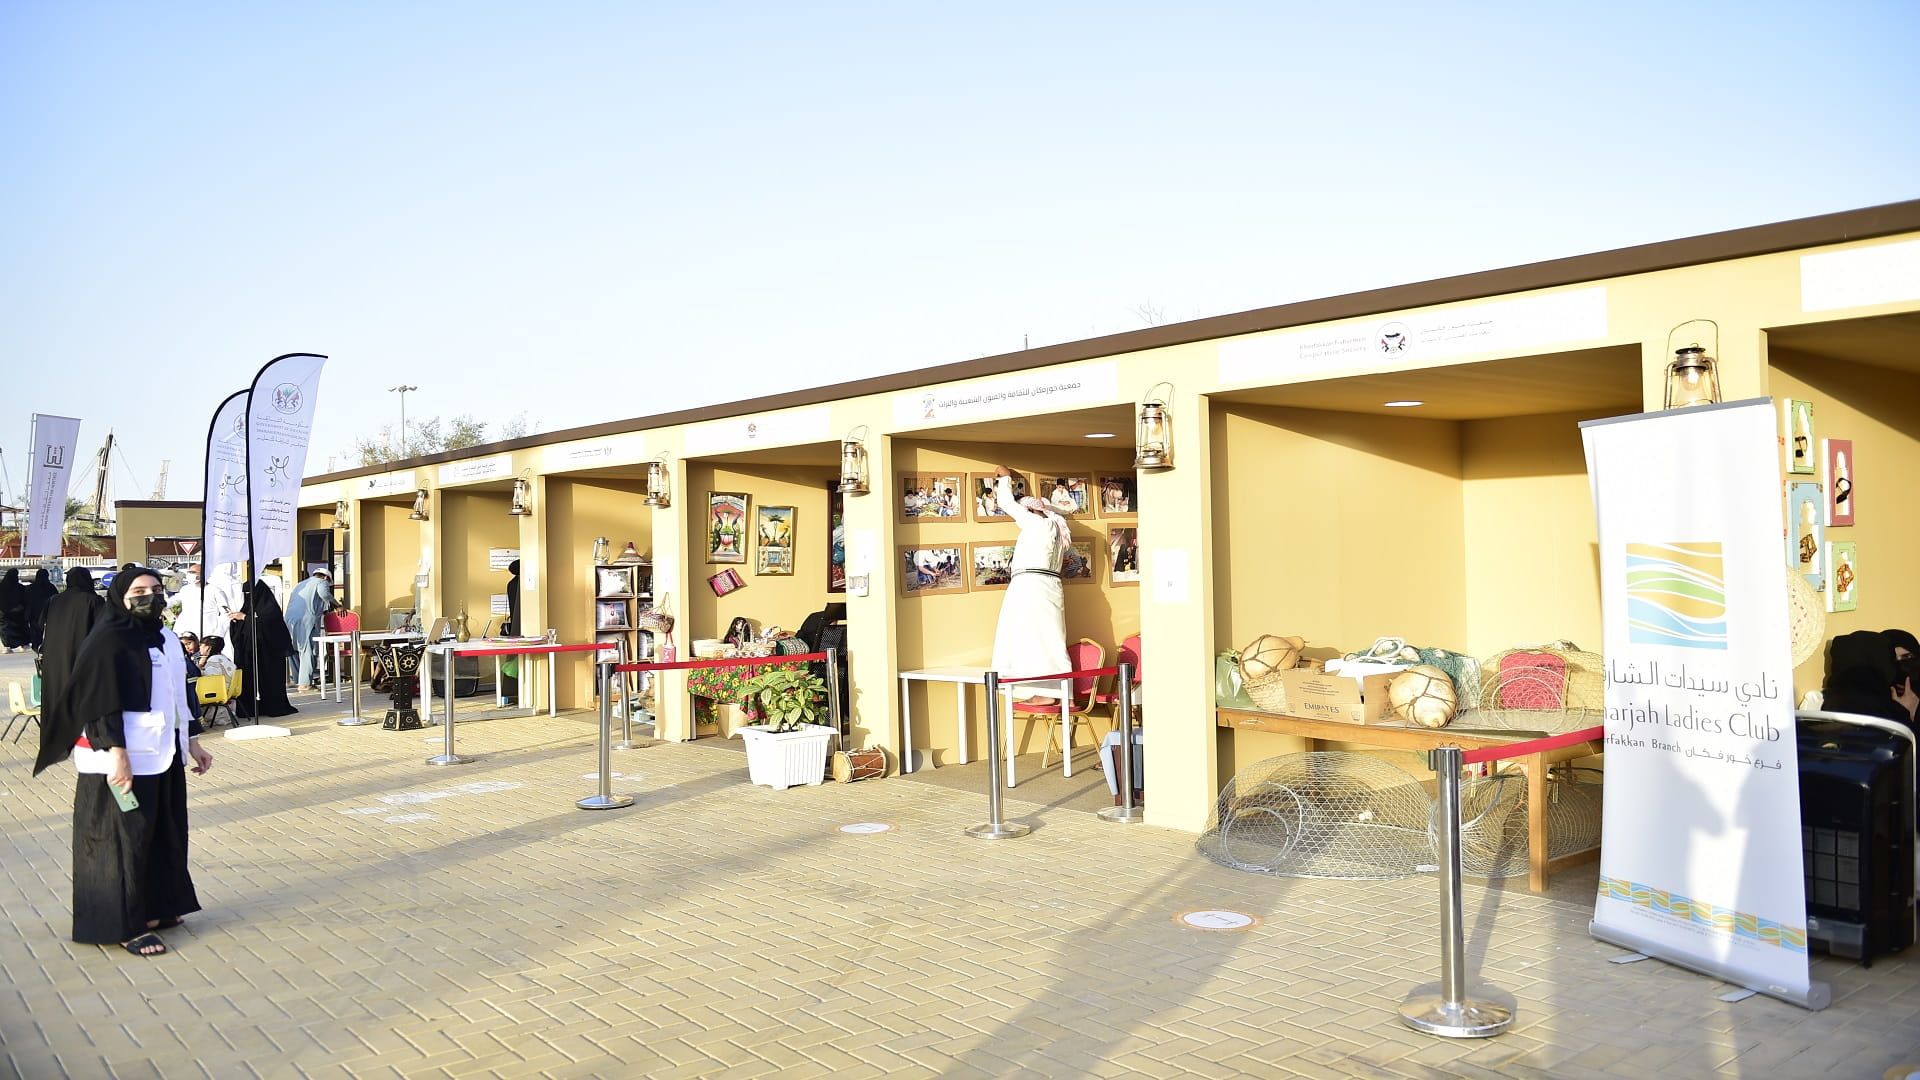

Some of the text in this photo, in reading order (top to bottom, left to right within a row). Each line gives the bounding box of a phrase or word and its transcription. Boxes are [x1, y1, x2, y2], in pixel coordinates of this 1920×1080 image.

[1664, 663, 1728, 697] سيدات
[1735, 671, 1778, 707] نادي
[1304, 702, 1340, 714] EMIRATES
[1665, 704, 1722, 734] Ladies
[1729, 712, 1780, 742] Club
[1605, 733, 1682, 753] rfakkan Branch
